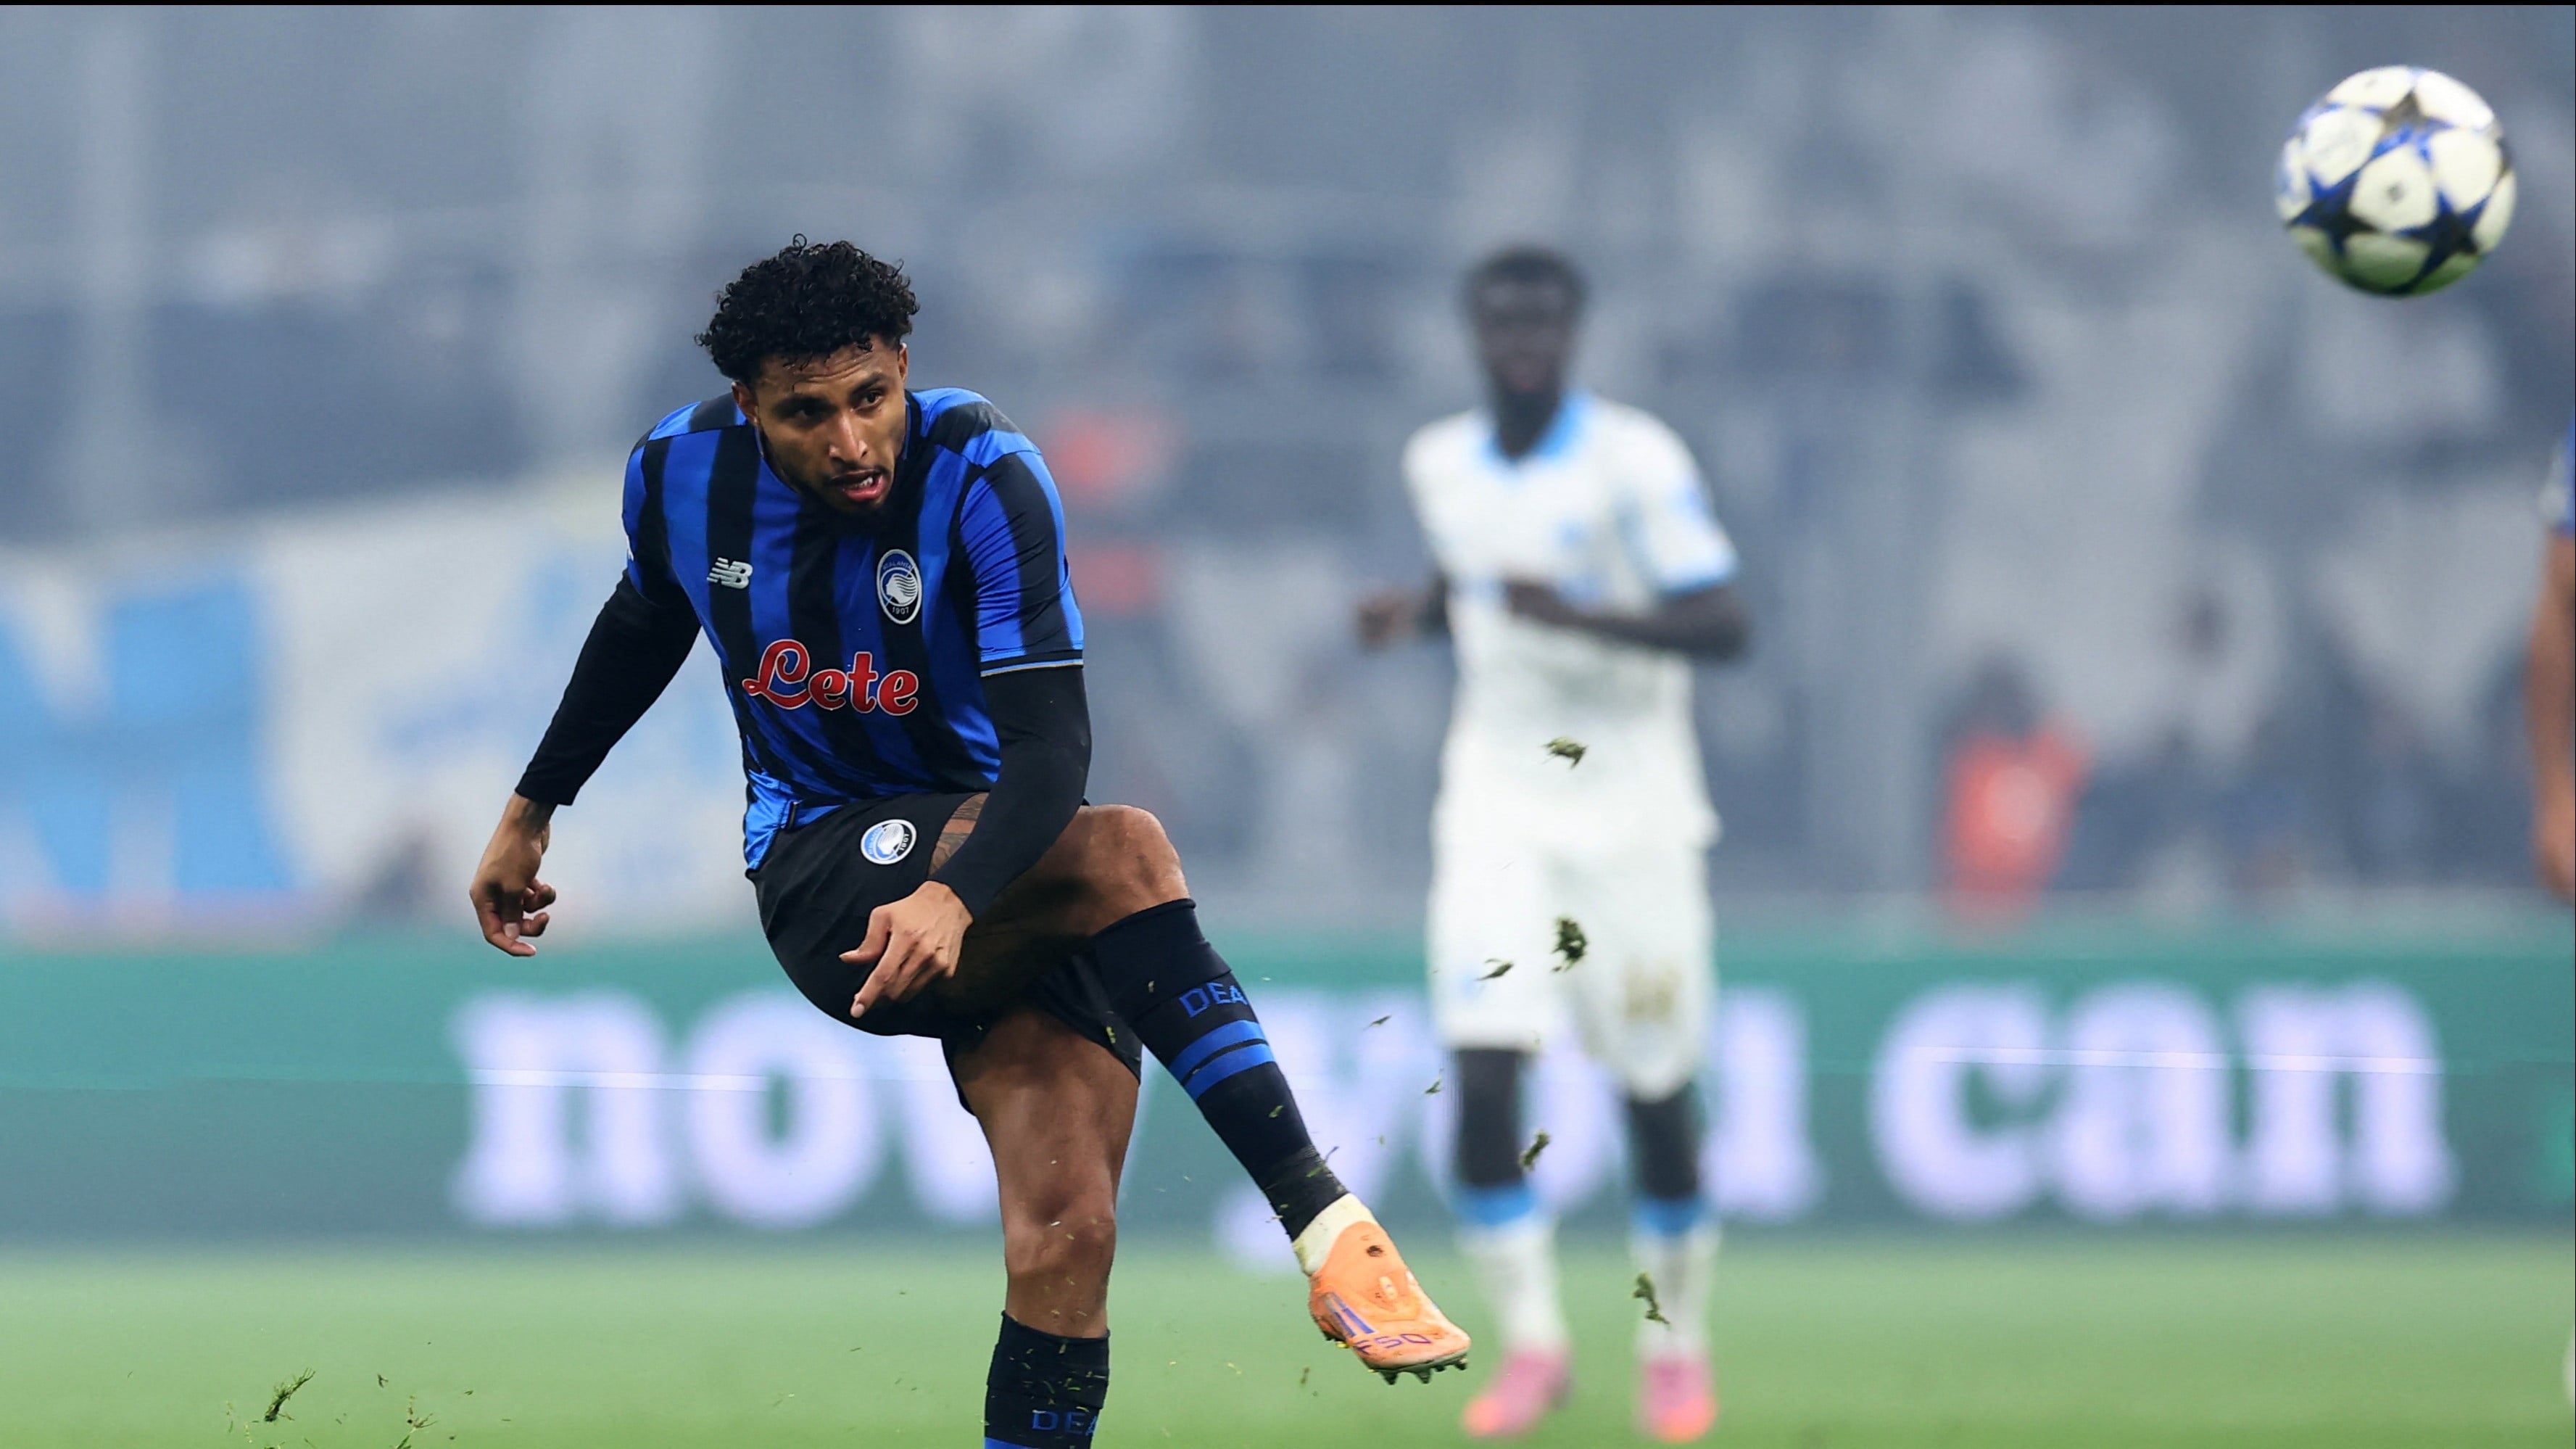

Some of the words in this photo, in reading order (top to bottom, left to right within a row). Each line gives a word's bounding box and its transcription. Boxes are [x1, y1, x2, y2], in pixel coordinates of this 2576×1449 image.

[742, 639, 919, 715] Lete
[1179, 982, 1248, 1018] DEA
[1872, 981, 2456, 1223] can
